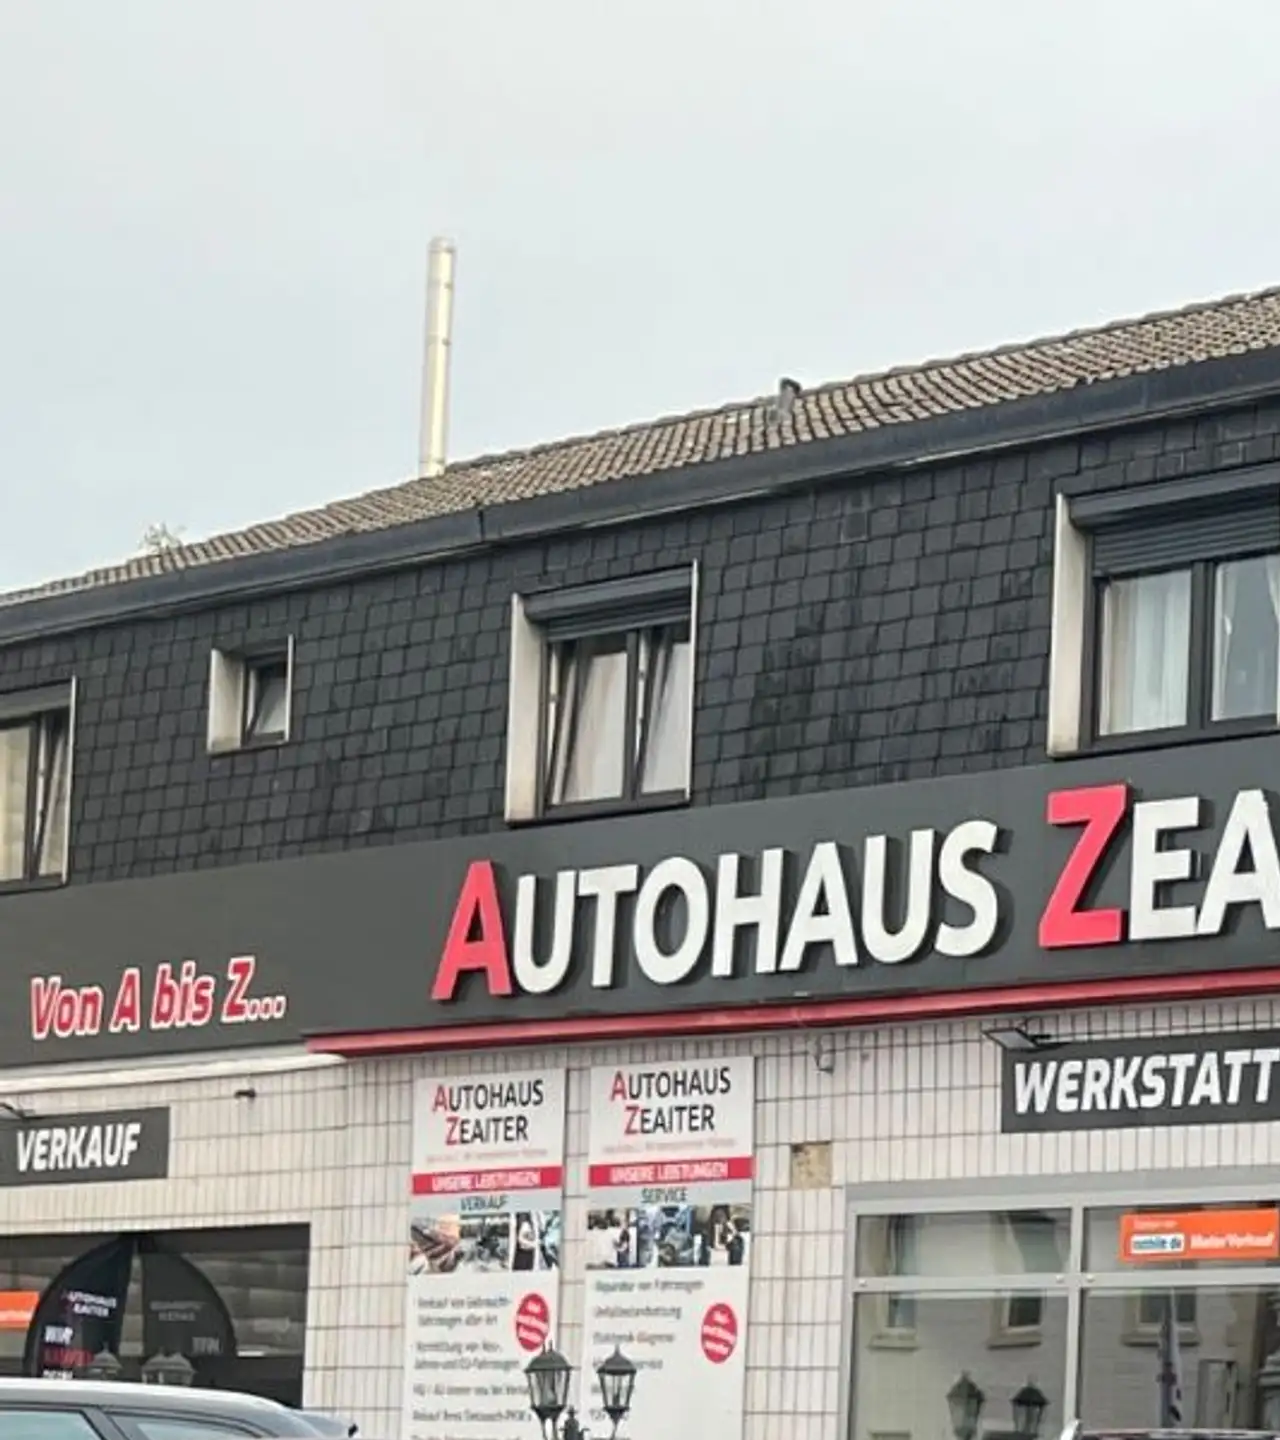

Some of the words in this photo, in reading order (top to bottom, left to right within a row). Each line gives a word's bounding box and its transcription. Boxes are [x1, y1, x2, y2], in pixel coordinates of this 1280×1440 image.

[430, 820, 1002, 1001] AUTOHAUS
[30, 975, 103, 1040] Von
[109, 980, 142, 1033] A
[150, 961, 215, 1029] bis
[432, 1079, 544, 1112] AUTOHAUS
[610, 1066, 731, 1102] AUTOHAUS
[444, 1115, 529, 1146] ZEAITER
[624, 1104, 715, 1136] ZEAITER
[16, 1122, 141, 1172] VERKAUF
[609, 1164, 655, 1185] UNSERE
[657, 1160, 729, 1182] LEISTUNGEN
[461, 1195, 507, 1211] VERKAUF
[641, 1187, 688, 1204] SERVICE
